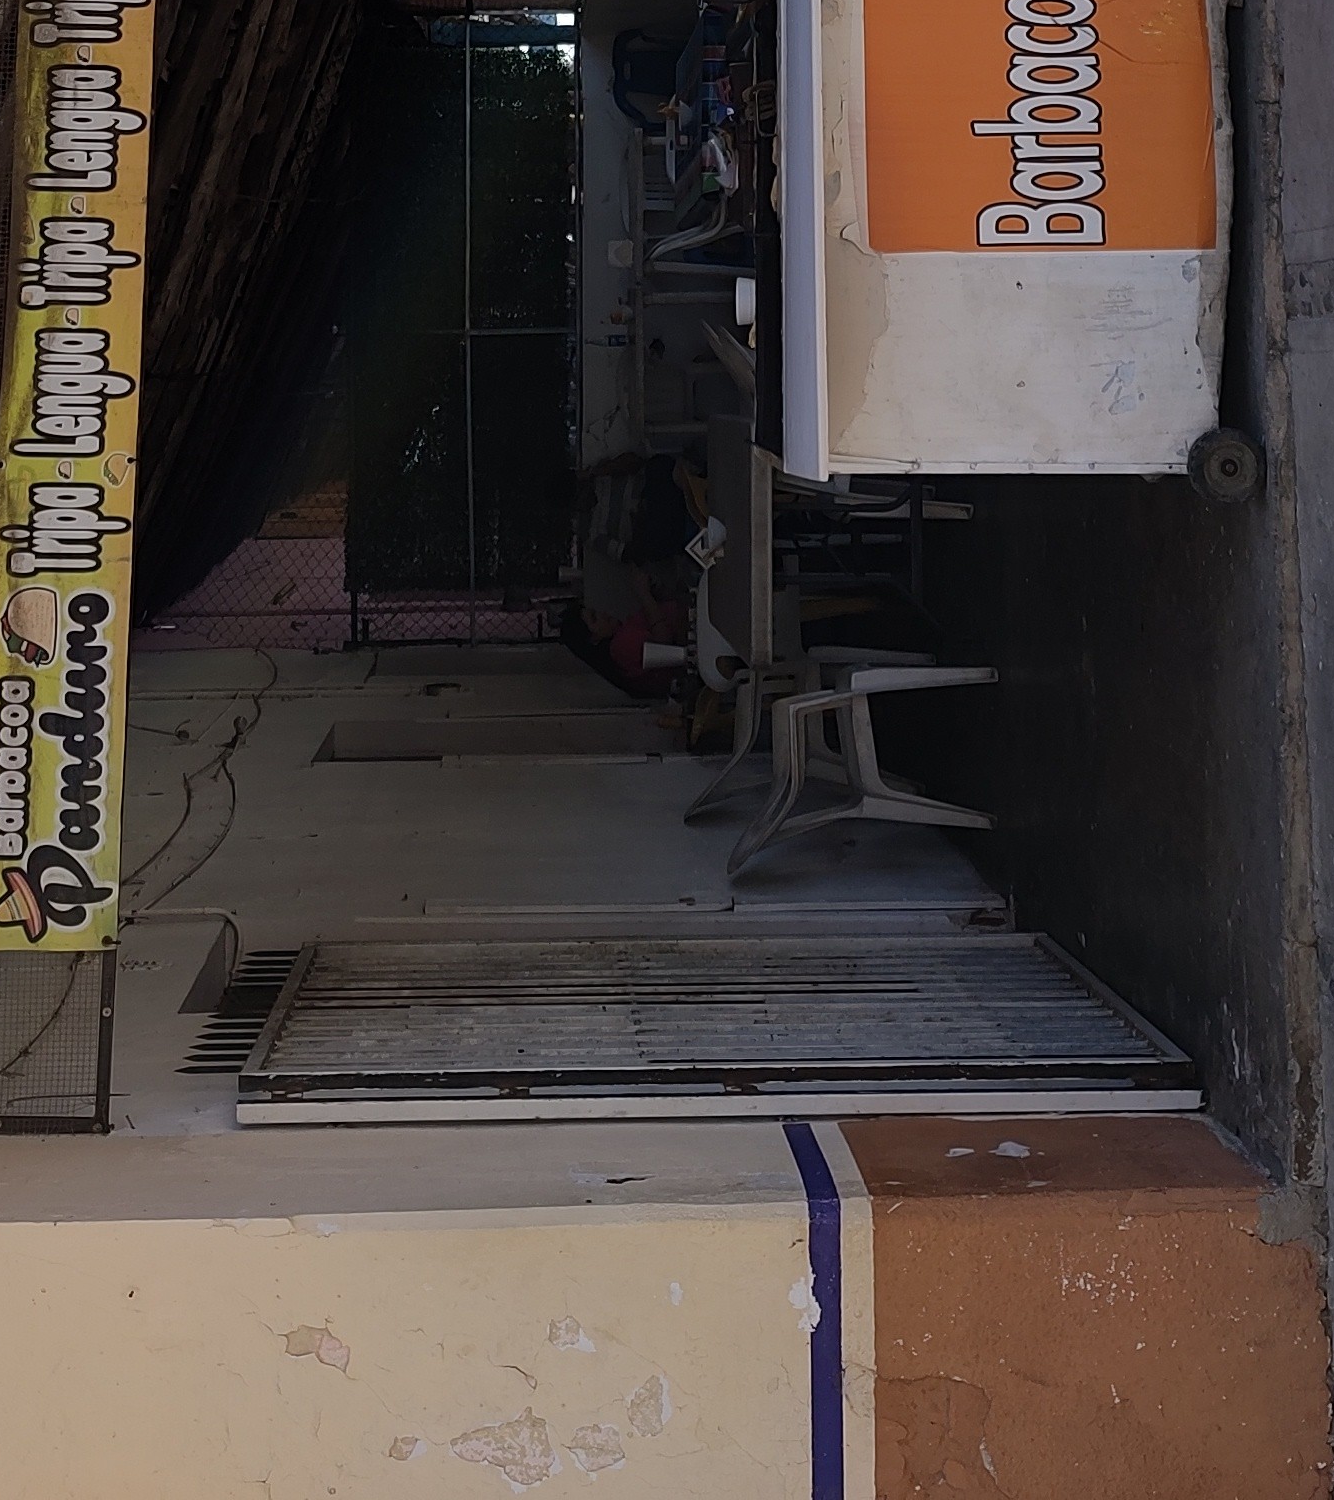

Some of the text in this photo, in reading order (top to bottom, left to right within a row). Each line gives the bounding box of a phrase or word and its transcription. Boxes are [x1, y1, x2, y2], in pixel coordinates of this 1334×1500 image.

[23, 65, 146, 191] Lengua
[15, 217, 141, 311] Tripa
[9, 328, 134, 457] Lengua
[0, 482, 131, 577] Tripa
[25, 591, 114, 928] Panduro
